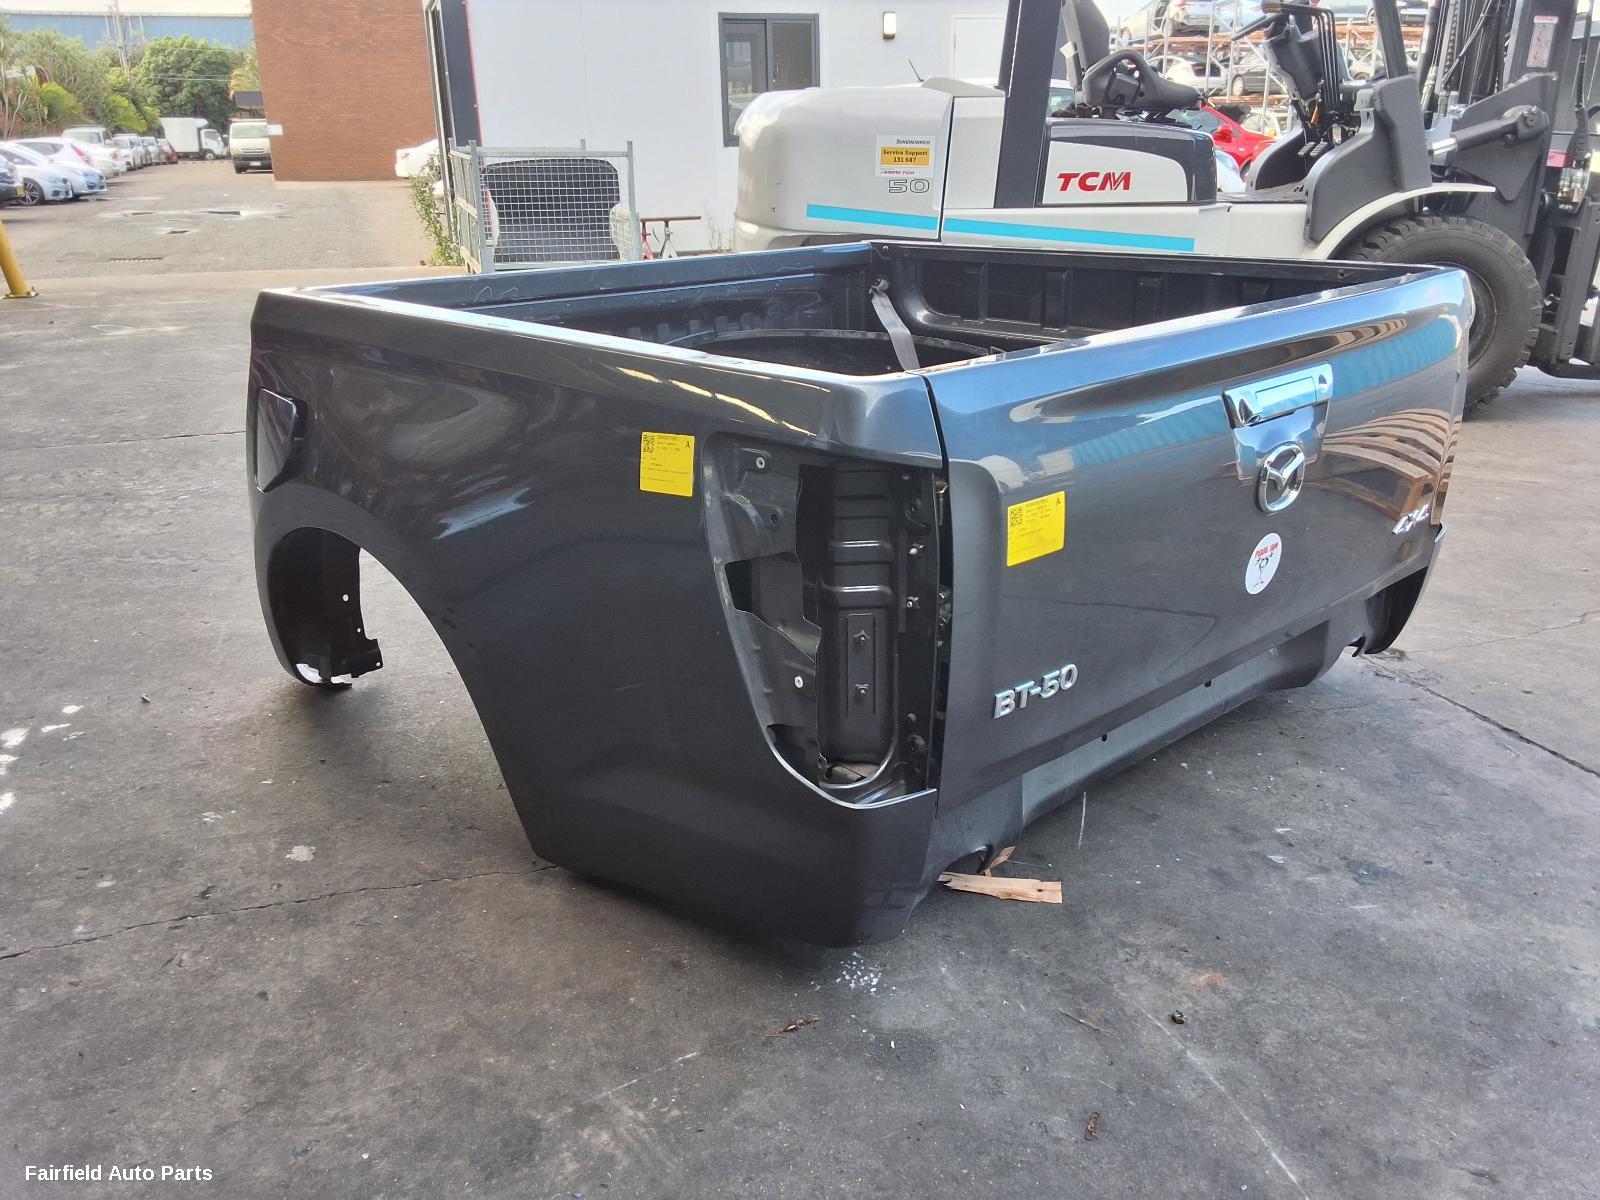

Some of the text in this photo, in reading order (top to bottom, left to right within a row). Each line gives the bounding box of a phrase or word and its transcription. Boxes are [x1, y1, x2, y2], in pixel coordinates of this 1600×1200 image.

[888, 178, 930, 194] 50
[1057, 171, 1131, 192] TCM
[685, 440, 691, 449] A
[1055, 497, 1061, 505] A
[993, 663, 1079, 720] BT-50
